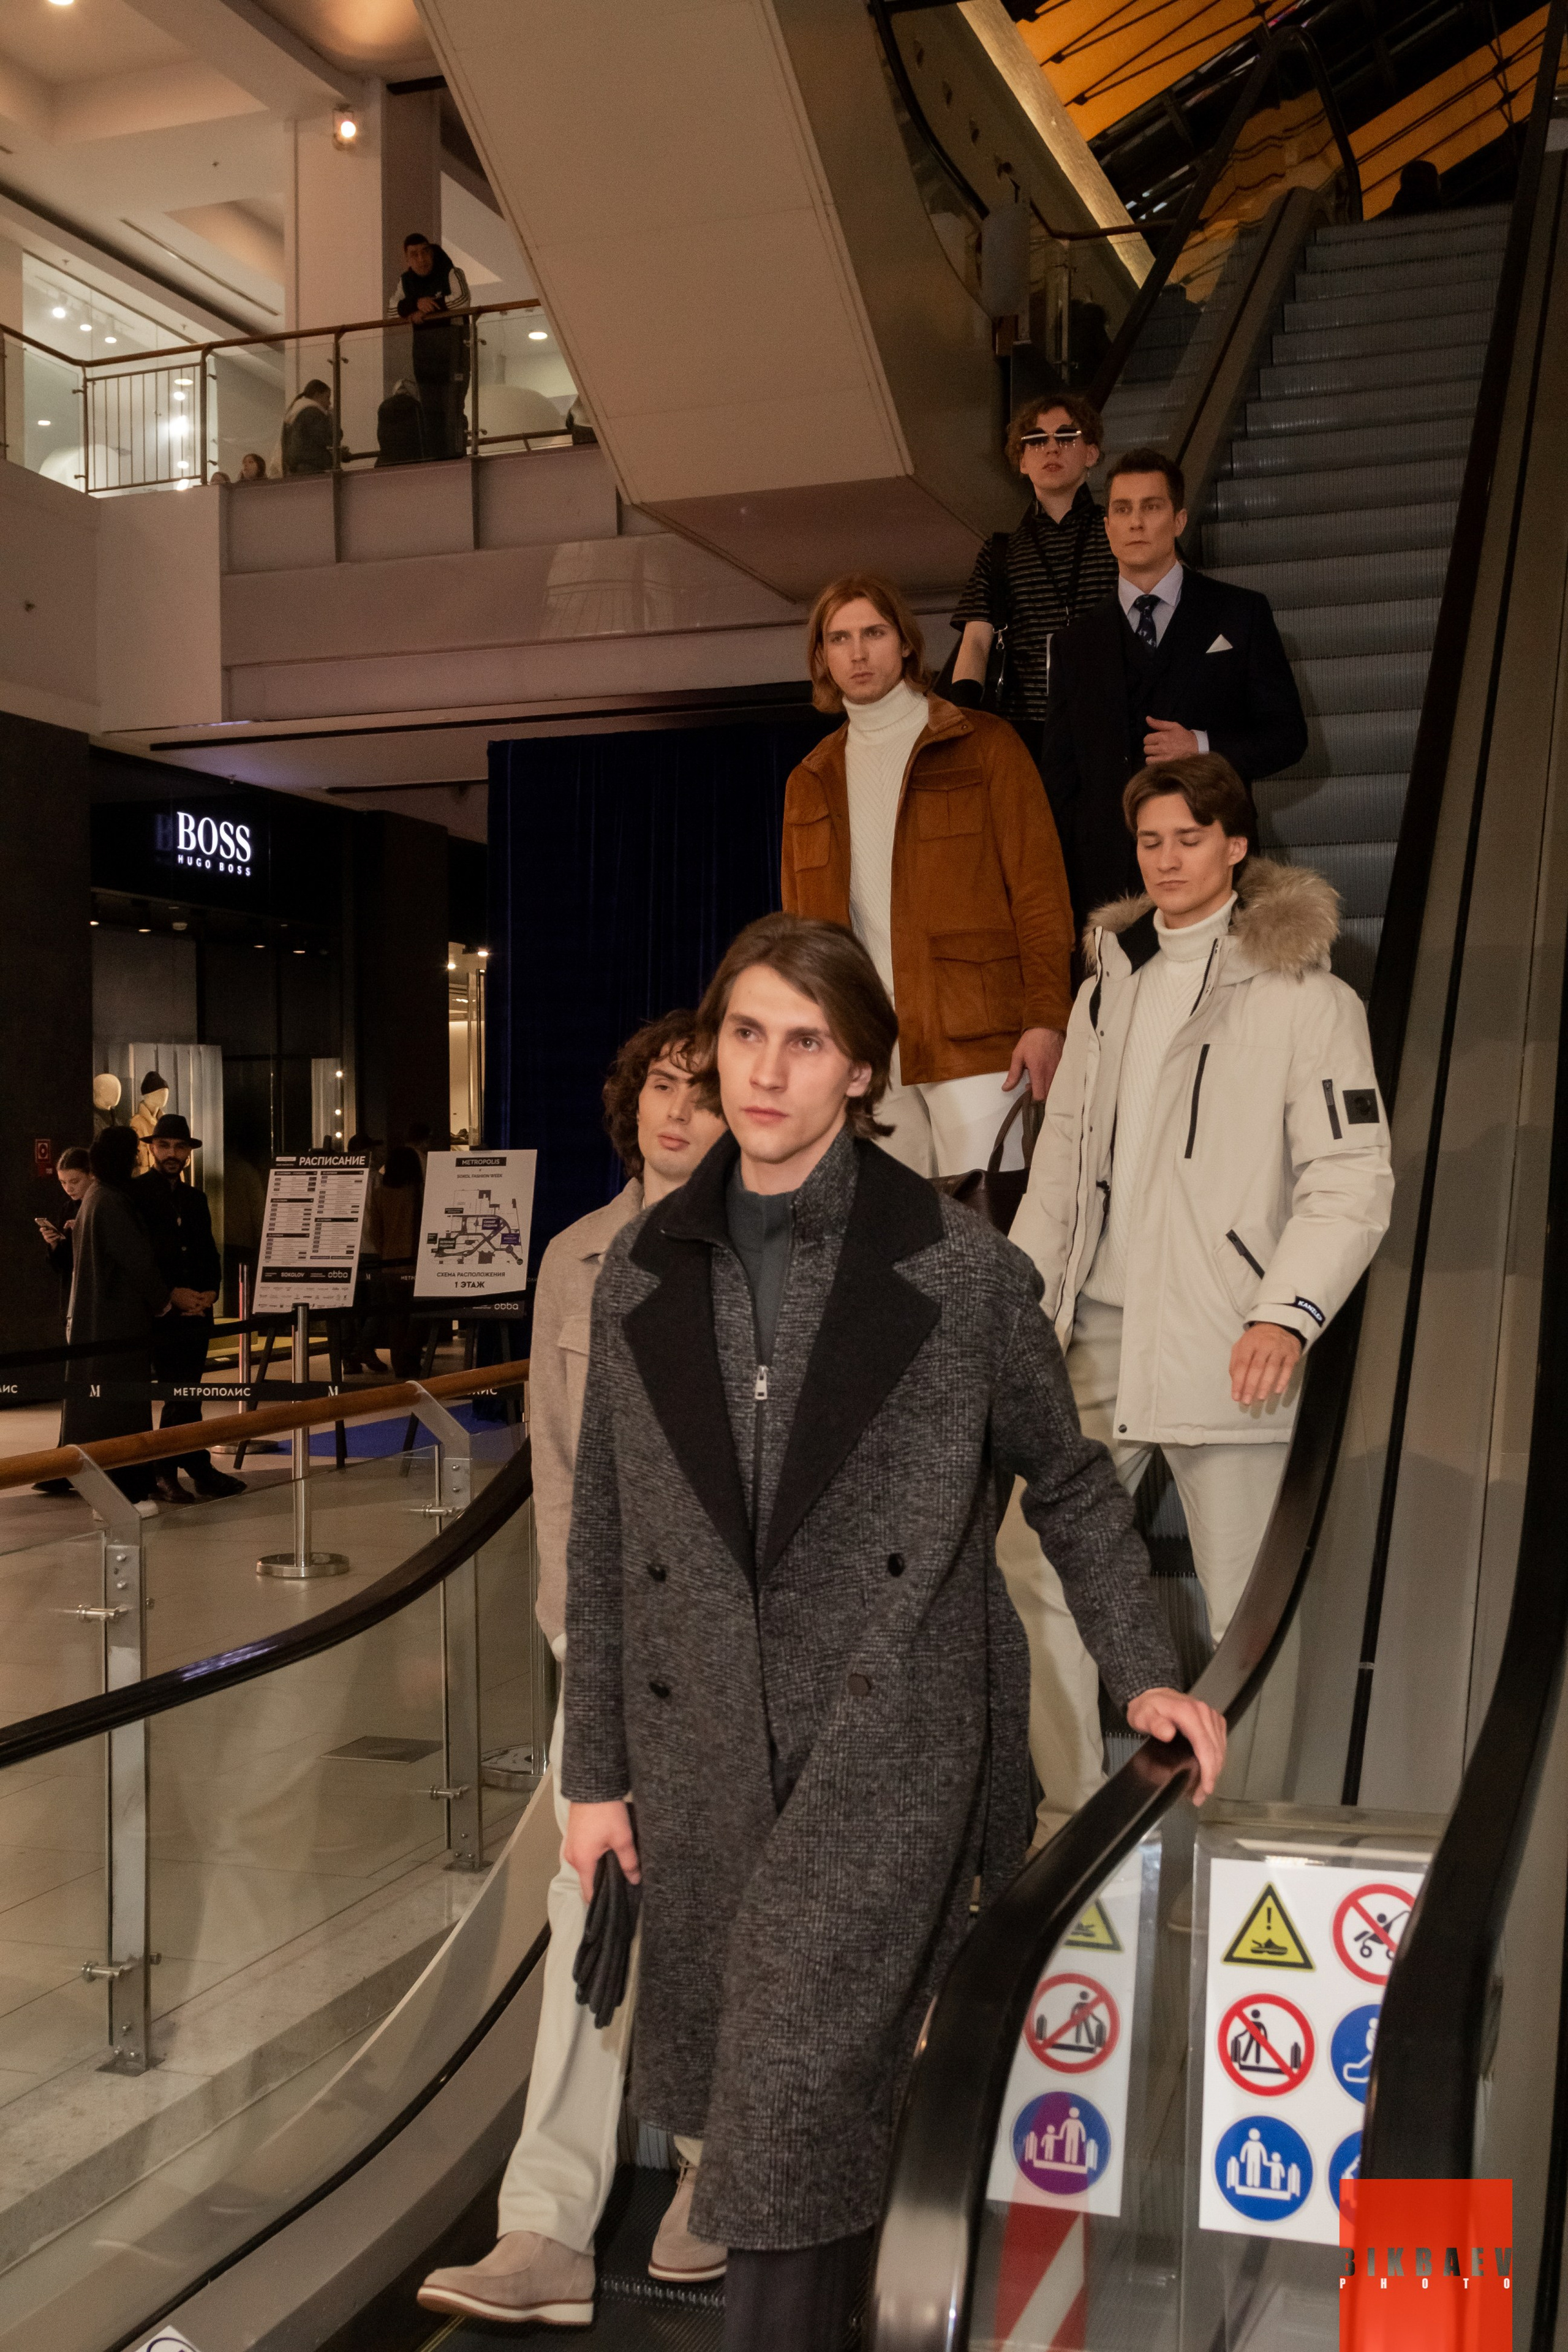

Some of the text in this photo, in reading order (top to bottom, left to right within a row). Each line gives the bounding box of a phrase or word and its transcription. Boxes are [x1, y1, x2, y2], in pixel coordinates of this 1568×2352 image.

[176, 812, 252, 862] BOSS
[178, 854, 252, 877] HUGO BOSS
[298, 1155, 366, 1166] РАСПИСАНИЕ
[173, 1387, 251, 1397] МЕТРОПОЛИС
